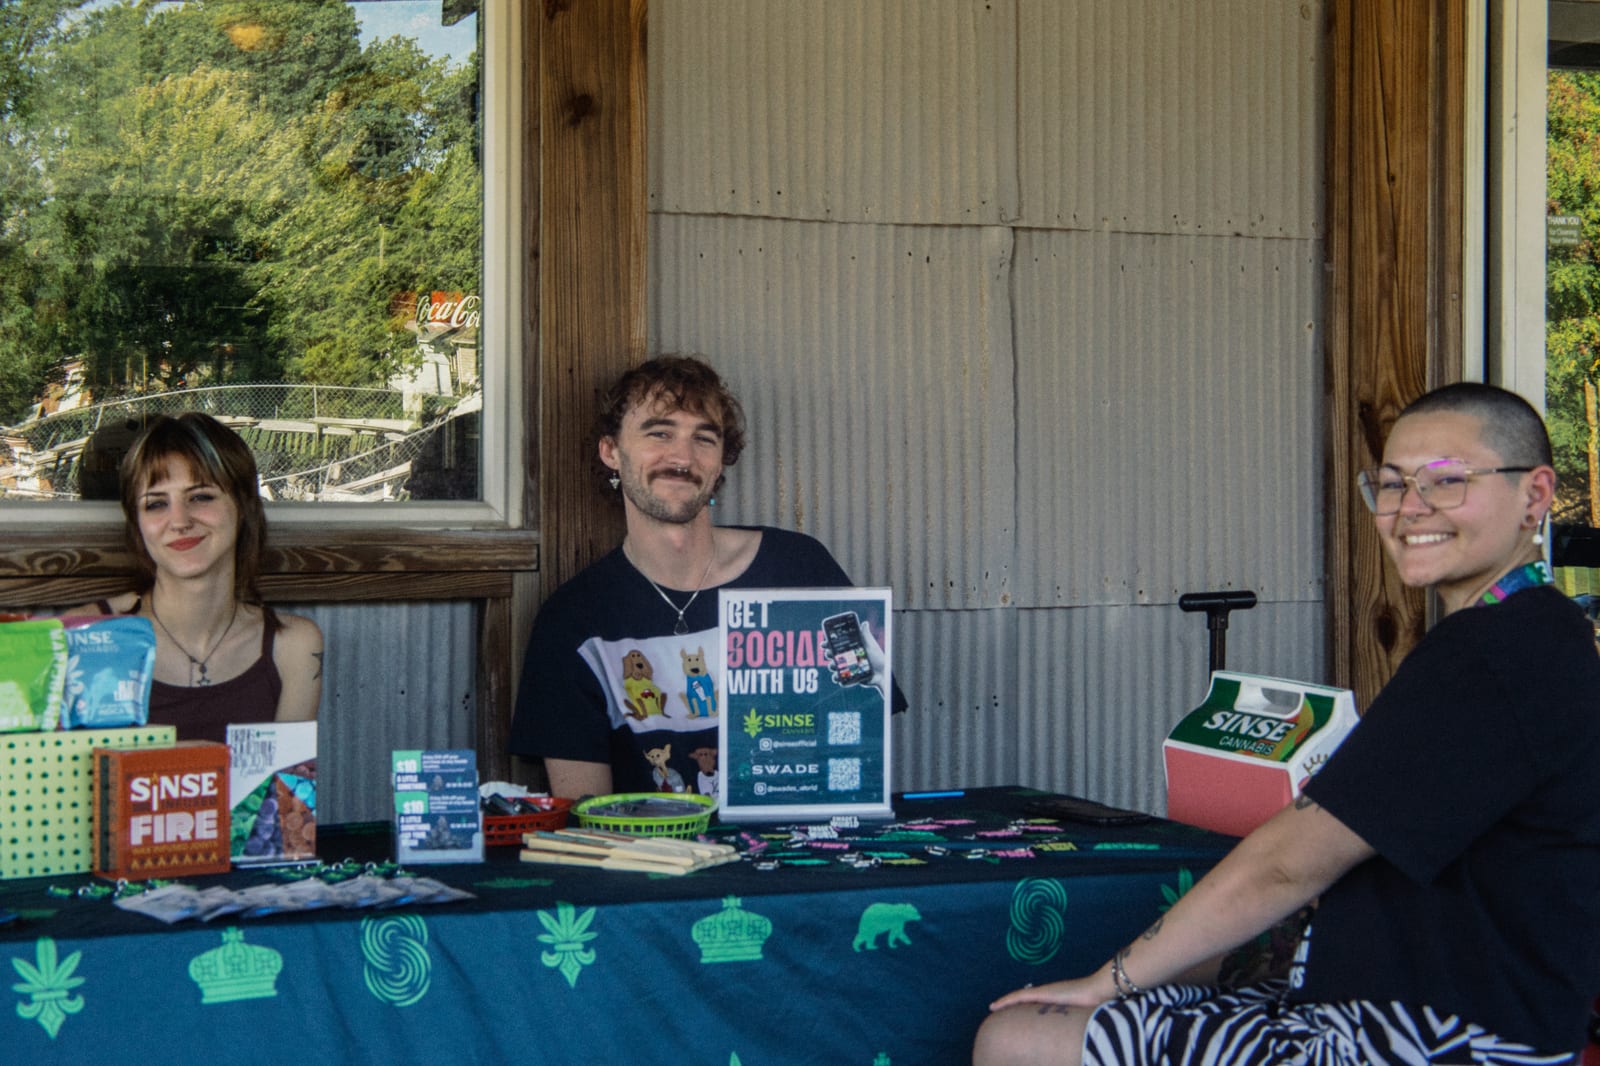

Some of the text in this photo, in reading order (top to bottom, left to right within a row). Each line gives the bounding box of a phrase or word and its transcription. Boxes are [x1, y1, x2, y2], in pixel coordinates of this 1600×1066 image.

[727, 600, 772, 628] GET
[67, 631, 114, 646] INSE
[727, 630, 830, 668] SOCIAL
[727, 668, 818, 695] WITH US
[764, 714, 815, 728] SINSE
[1203, 711, 1296, 742] SINSE
[1219, 735, 1275, 756] CANNABIS
[396, 759, 417, 774] $10
[752, 764, 819, 775] SWADE
[403, 800, 424, 814] $10
[130, 809, 218, 846] FIRE
